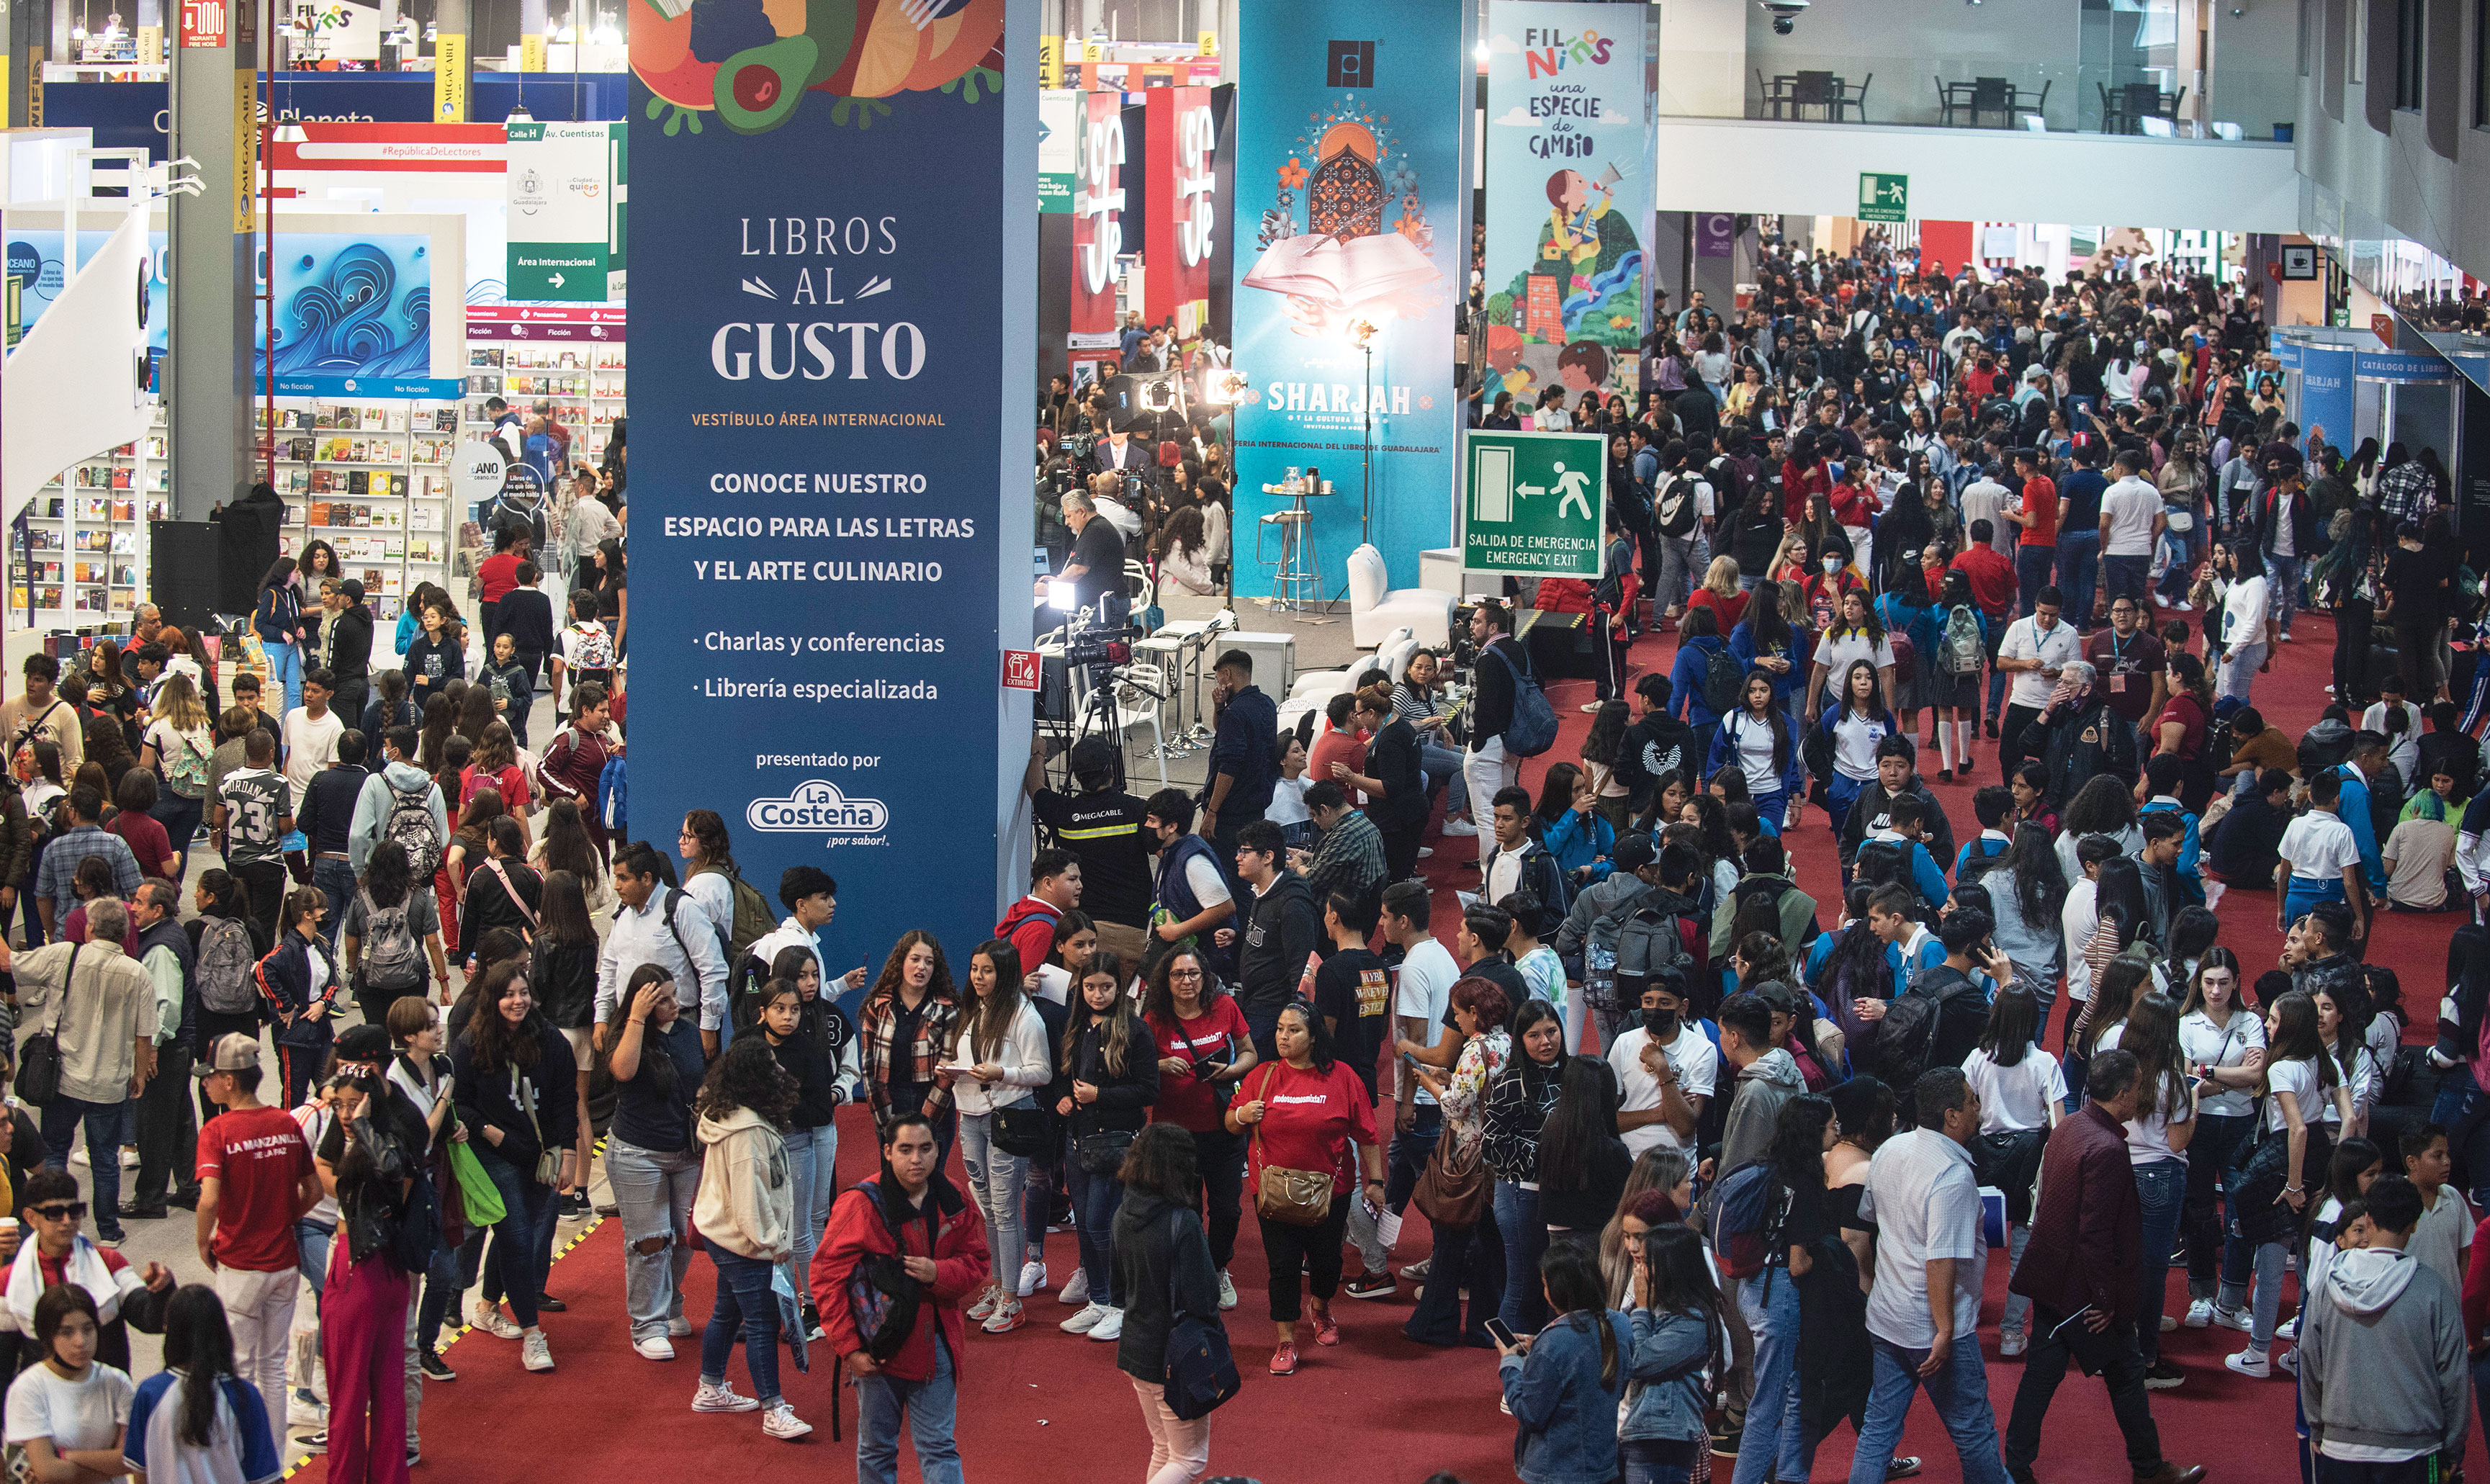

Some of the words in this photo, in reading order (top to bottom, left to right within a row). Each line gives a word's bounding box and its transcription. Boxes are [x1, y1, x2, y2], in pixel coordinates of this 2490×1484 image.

[297, 4, 317, 17] FIL
[1526, 28, 1565, 47] FIL
[1525, 30, 1614, 79] Niños
[444, 39, 454, 102] MEGACABLE
[1550, 84, 1586, 93] una
[1530, 95, 1601, 118] ESPECIE
[529, 129, 536, 138] H
[1552, 117, 1574, 132] de
[241, 81, 250, 194] MEGACABLE
[382, 146, 482, 156] #RepúblicaDeLectores
[569, 183, 598, 192] quiero
[1709, 215, 1730, 236] C
[741, 216, 897, 255] LIBROS
[518, 256, 537, 266] Área
[539, 257, 596, 267] Internacional
[792, 267, 844, 305] AL
[711, 321, 927, 381] GUSTO
[2362, 360, 2404, 372] CATÁLOGO
[2407, 363, 2417, 372] DE
[2420, 362, 2447, 373] LIBROS
[1267, 381, 1411, 415] SHARJAH
[691, 411, 775, 426] VESTÍBULO
[779, 411, 818, 426] ÁREA
[822, 413, 945, 426] INTERNACIONAL
[1259, 441, 1323, 449] INTERNACIONAL
[709, 472, 807, 494] CONOCE
[814, 473, 927, 495] NUESTRO
[1662, 493, 1685, 516] NIKE
[664, 516, 763, 537] ESPACIO
[769, 517, 830, 538] PARA
[836, 518, 878, 538] LAS
[886, 518, 975, 539] LETRAS
[1469, 534, 1507, 547] SALIDA
[1511, 535, 1524, 548] DE
[1528, 536, 1596, 551] EMERGENCIA
[1486, 551, 1550, 565] EMERGENCY
[1554, 554, 1577, 567] EXIT
[694, 560, 709, 580] Y
[714, 561, 741, 580] EL
[747, 560, 806, 581] ARTE
[813, 561, 943, 582] CULINARIO
[704, 631, 785, 652] Charlas
[790, 636, 803, 656] y
[807, 632, 945, 653] conferencias
[704, 678, 787, 699] Librería
[793, 680, 938, 703] especializada
[1007, 678, 1034, 687] EXTINTOR
[755, 752, 848, 769] presentado
[852, 755, 881, 770] por
[225, 781, 263, 799] JORDAN
[806, 787, 830, 804] La
[226, 799, 269, 843] 23
[760, 803, 874, 827] Costeña
[827, 835, 850, 848] ¡por
[851, 835, 886, 847] sabor!
[1171, 1031, 1222, 1050] #todosmosmixta77
[1273, 1094, 1326, 1104] #todossomosmixta77
[226, 1142, 243, 1155] LA
[274, 1147, 287, 1156] PAZ
